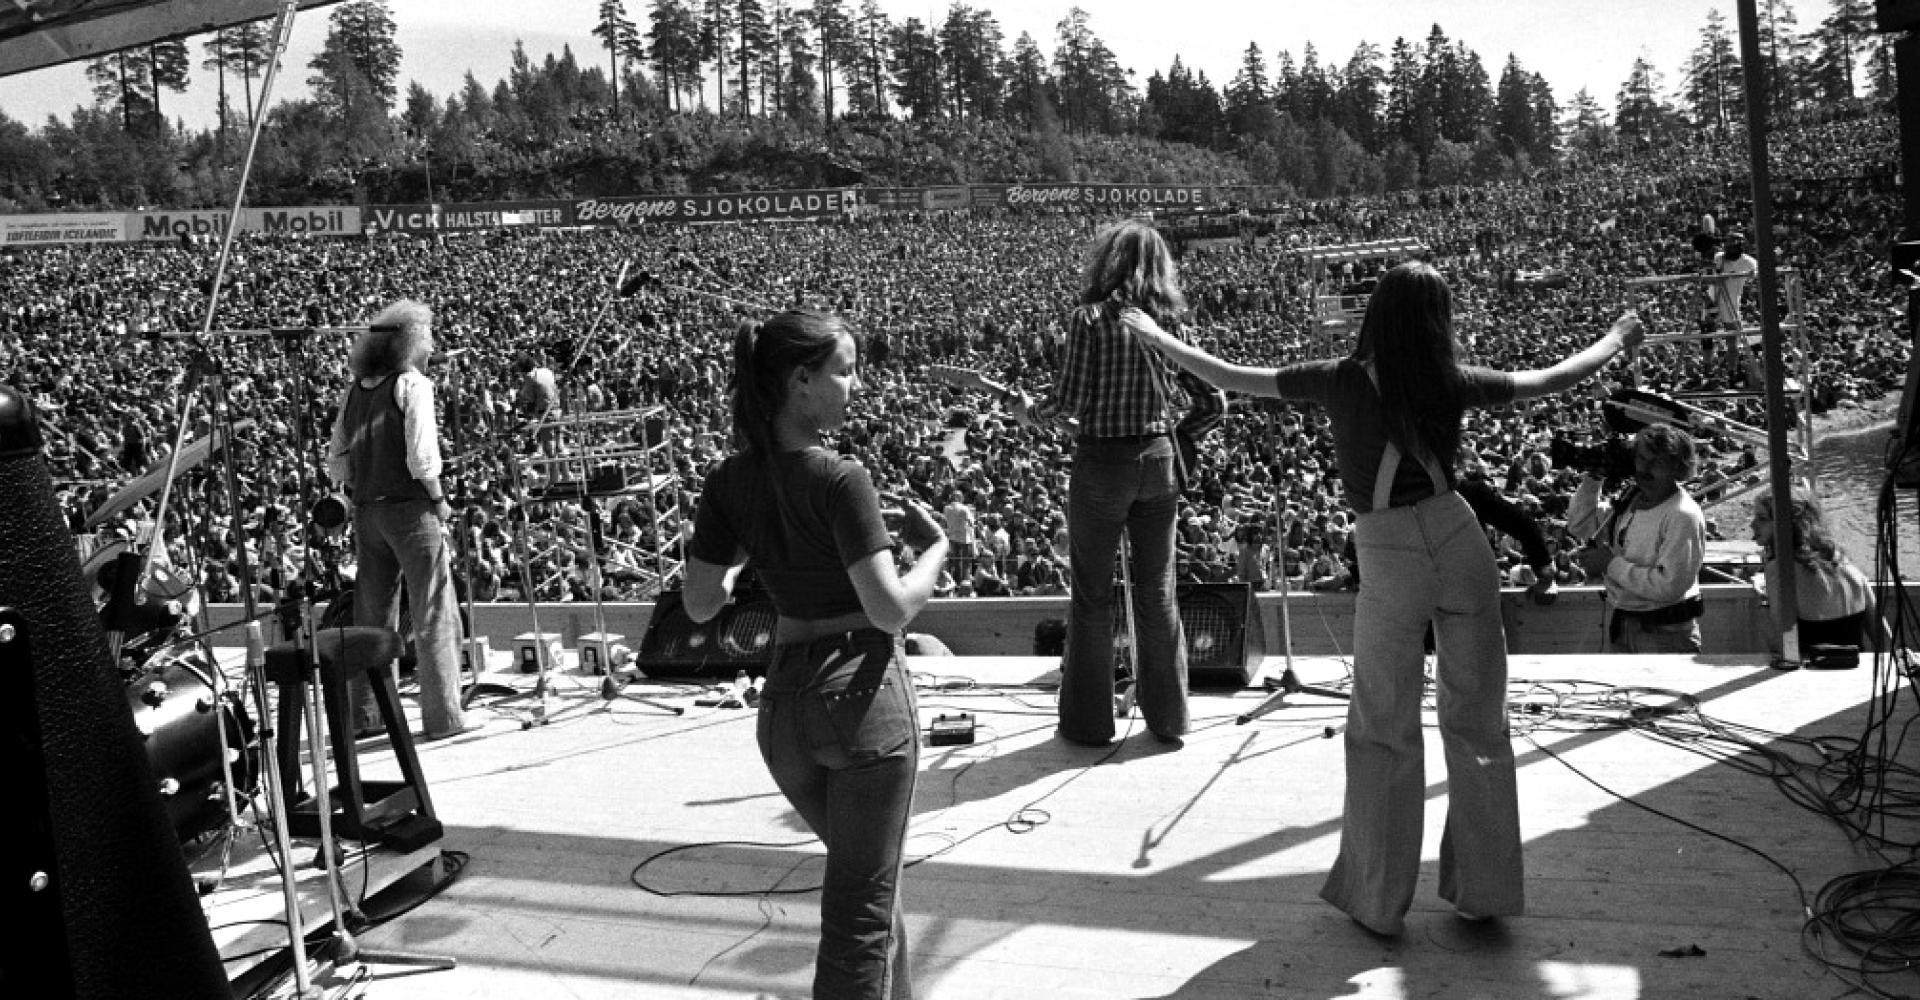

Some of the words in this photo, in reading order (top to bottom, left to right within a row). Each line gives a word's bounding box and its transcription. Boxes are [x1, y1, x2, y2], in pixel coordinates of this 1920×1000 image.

[1006, 186, 1080, 202] Bergene
[1084, 188, 1202, 203] SJOKOLADE
[576, 199, 679, 222] Bergene
[683, 194, 838, 217] SJOKOLADE
[144, 214, 227, 236] Mobil
[264, 210, 342, 232] Mobil
